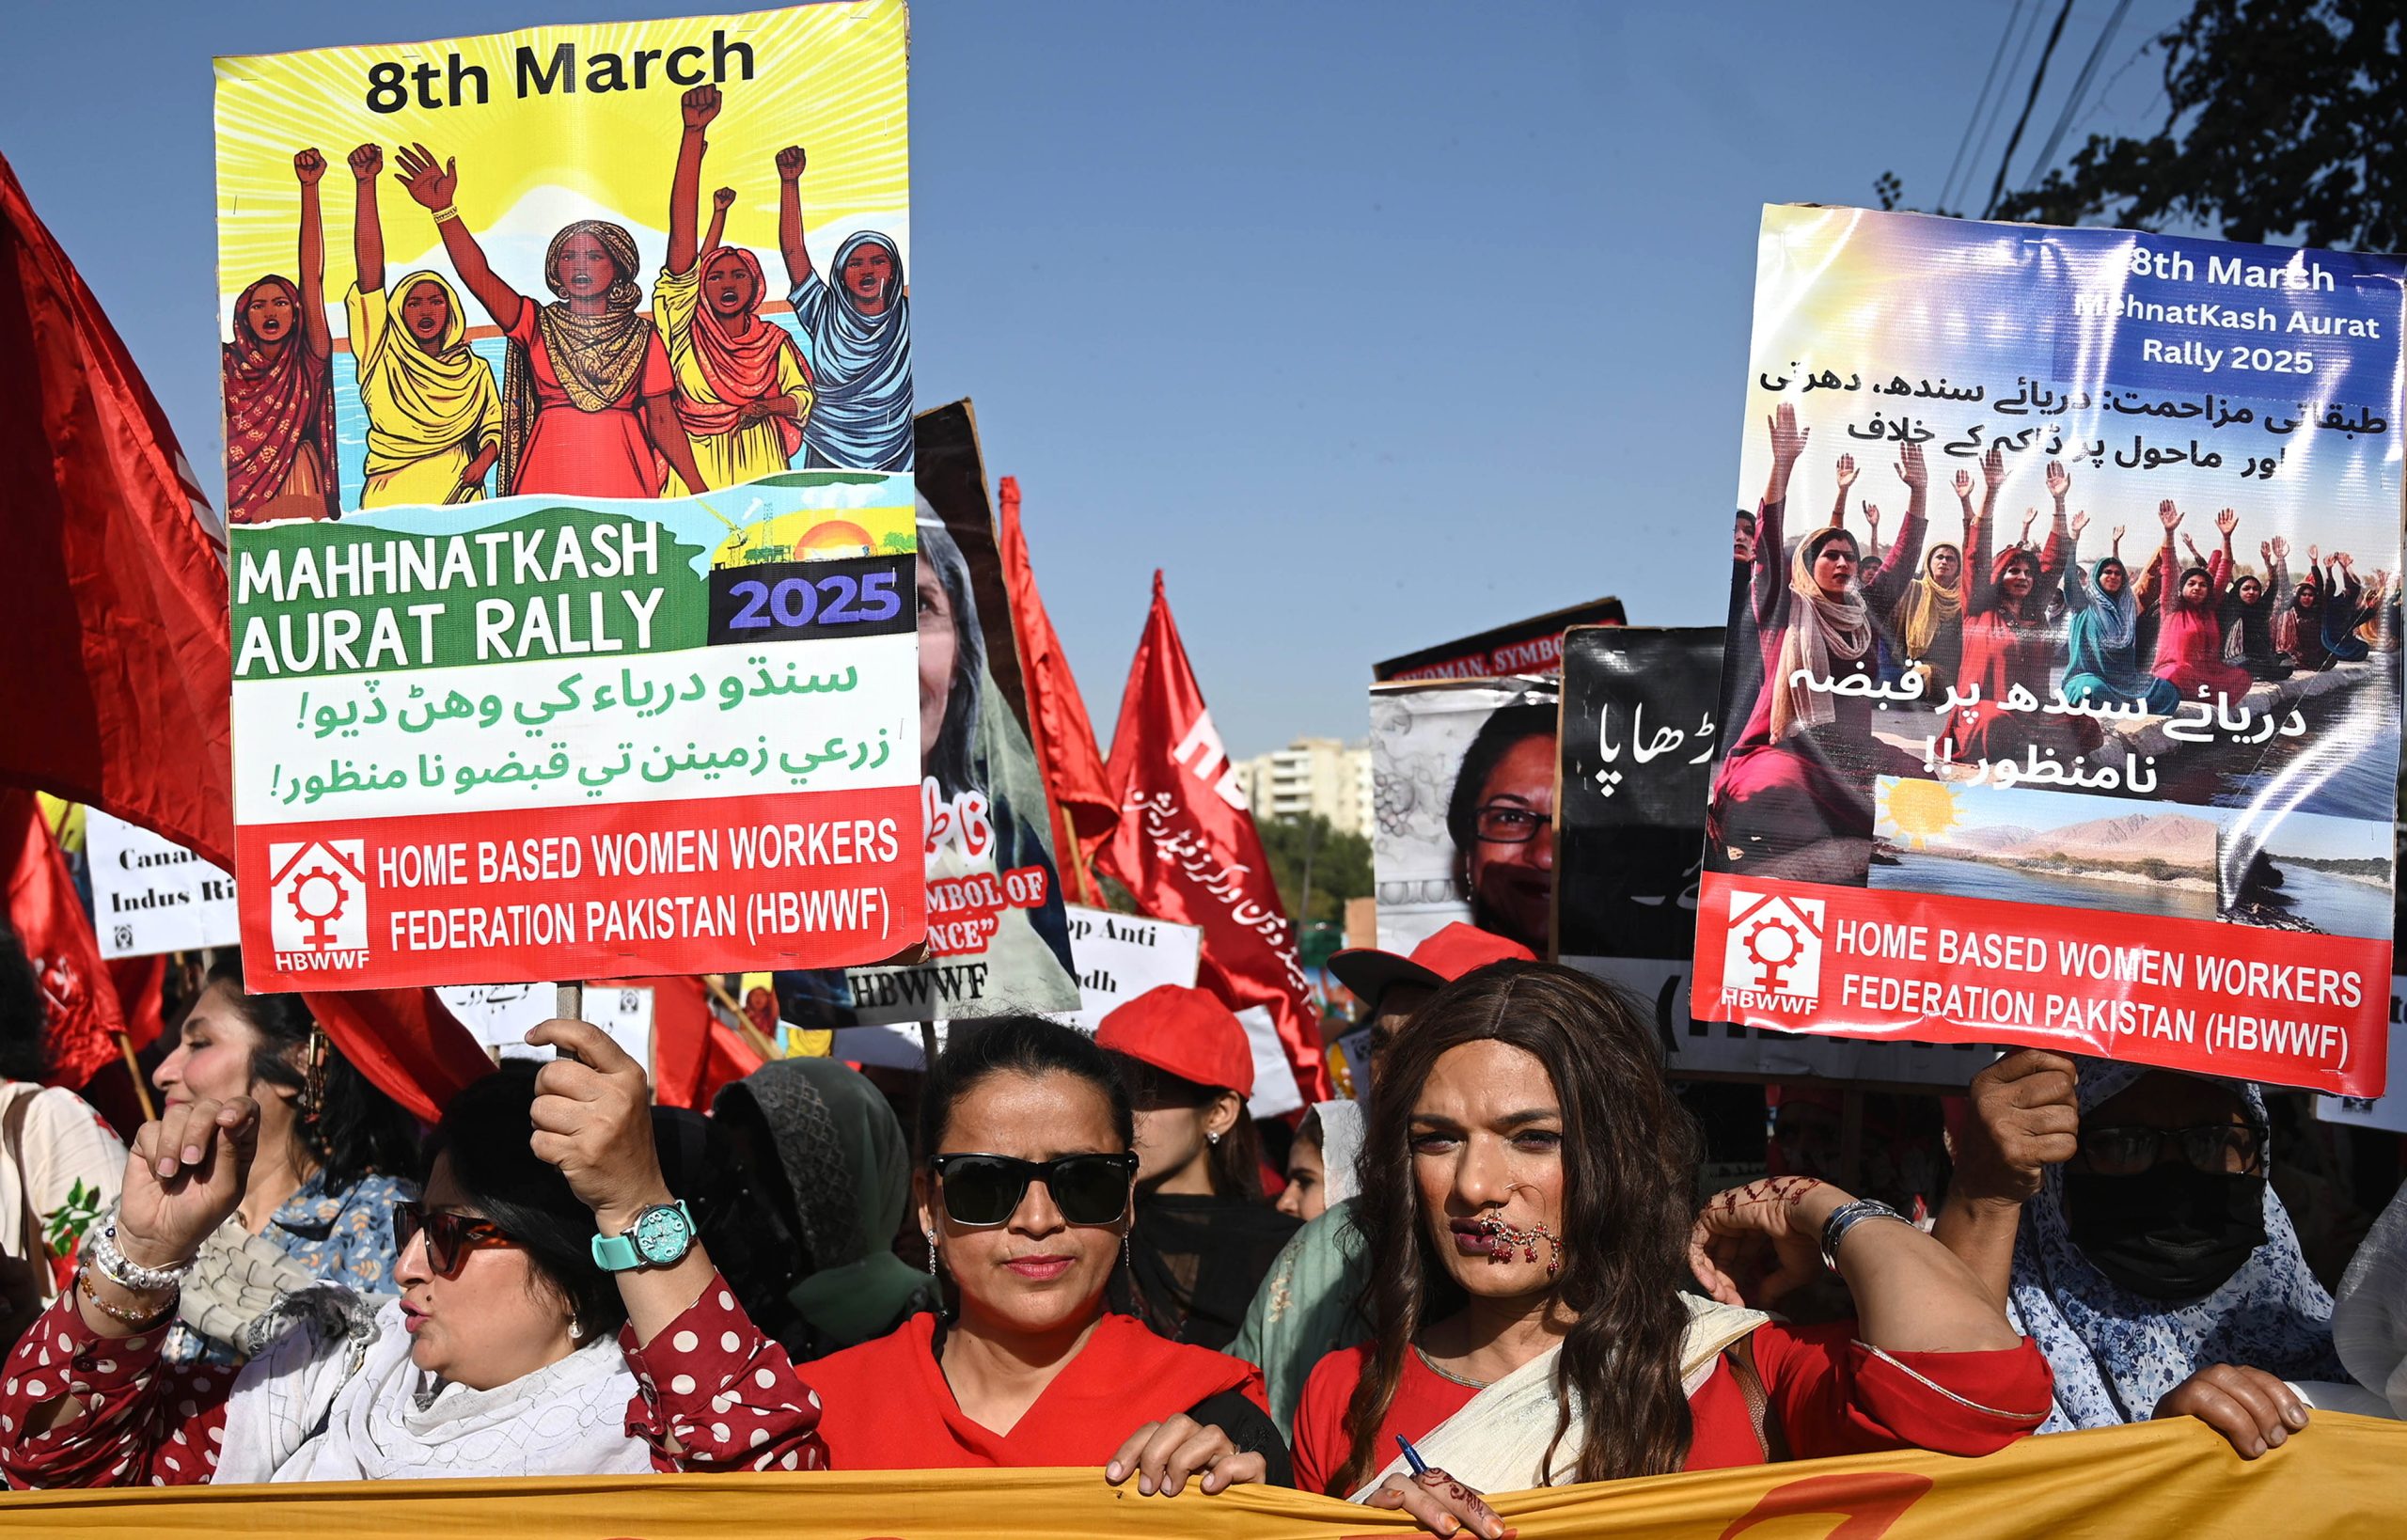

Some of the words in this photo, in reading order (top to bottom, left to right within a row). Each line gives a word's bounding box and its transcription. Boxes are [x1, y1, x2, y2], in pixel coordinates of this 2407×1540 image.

[366, 53, 491, 115] 8th
[515, 30, 754, 99] March
[2131, 247, 2194, 282] 8th
[2208, 255, 2335, 291] March
[2074, 292, 2276, 332] MehnatKash
[2286, 310, 2381, 339] Aurat
[2143, 338, 2224, 374] Rally
[2231, 347, 2314, 375] 2025
[1848, 411, 1935, 444] خلاف
[2102, 391, 2254, 429] مزاحمت:
[1943, 424, 1986, 457] کے
[2071, 436, 2106, 469] پر
[2115, 435, 2223, 470] ماحول
[2241, 446, 2288, 479] اور
[237, 522, 659, 605] MAHHNATKASH
[729, 573, 902, 629] 2025
[234, 603, 445, 677] AURAT
[475, 587, 664, 661] RALLY
[1495, 637, 1563, 671] SYMBO
[1789, 657, 1926, 711] قبضہ
[1934, 677, 1982, 724] پر
[1995, 680, 2149, 719] سندھ
[2161, 684, 2308, 745] دریائے
[454, 742, 570, 795] قبضو
[1596, 702, 1715, 798] ڑھاپا
[378, 842, 467, 888] HOME
[478, 835, 582, 885] BASED
[590, 827, 717, 879] WOMEN
[727, 818, 900, 870] WORKERS
[112, 888, 190, 913] Indus
[201, 878, 235, 902] Ri
[927, 877, 1001, 914] MBOL
[1006, 872, 1043, 902] OF
[390, 901, 576, 952] FEDERATION
[586, 892, 736, 943] PAKISTAN
[745, 887, 891, 950] (HBWWF)
[1098, 918, 1156, 947] Anti
[275, 950, 370, 972] HBWWF
[1836, 919, 1927, 963] HOME
[1938, 929, 2046, 973] BASED
[2058, 940, 2184, 987] WOMEN
[2195, 954, 2362, 1008] WORKERS
[849, 962, 988, 1009] HBWWF
[1721, 988, 1818, 1015] HBWWF
[1842, 974, 2035, 1025] FEDERATION
[2045, 996, 2195, 1044] PAKISTAN
[2205, 1010, 2348, 1069] (HBWWF)
